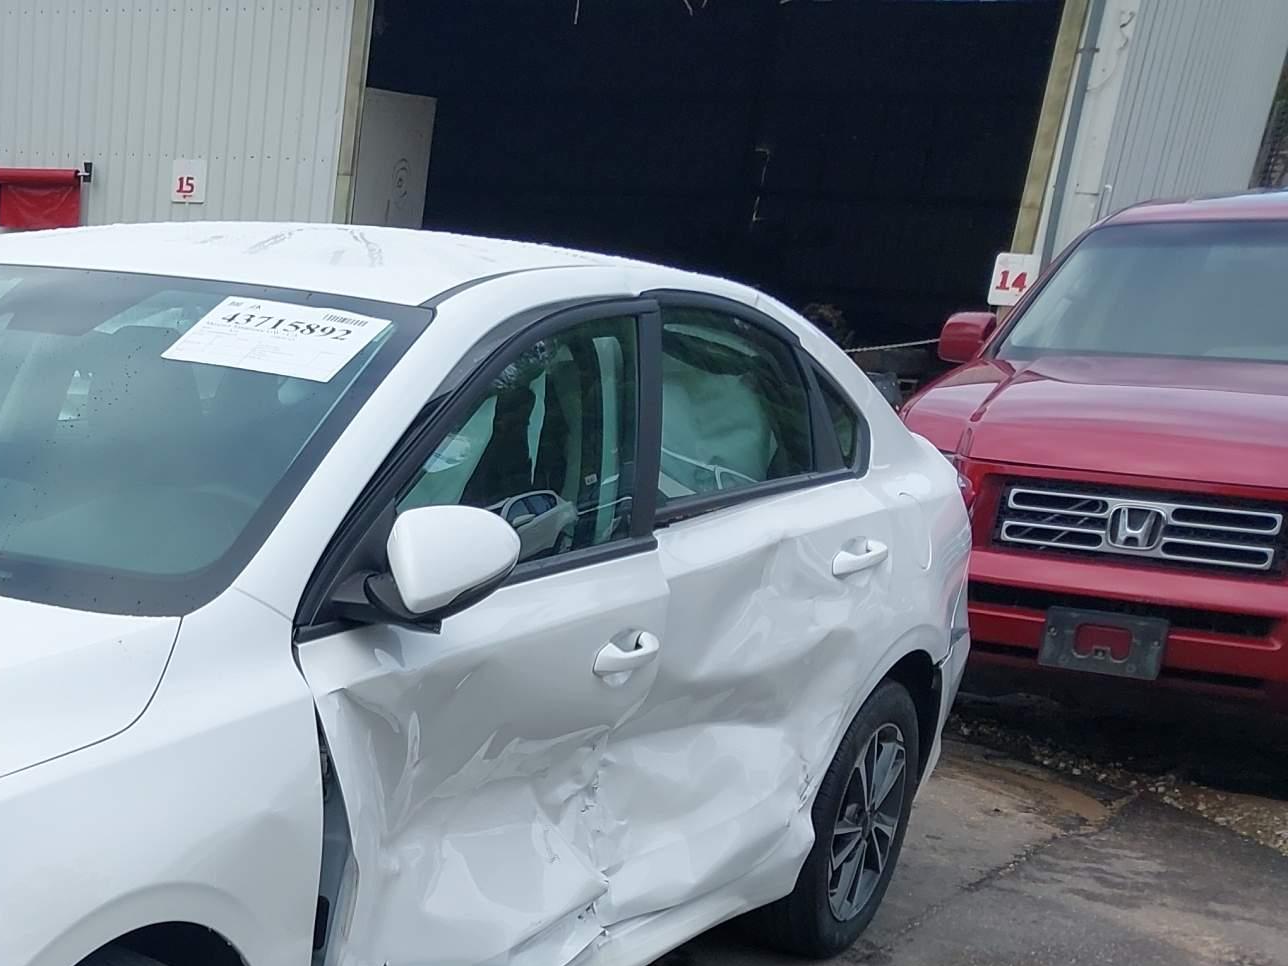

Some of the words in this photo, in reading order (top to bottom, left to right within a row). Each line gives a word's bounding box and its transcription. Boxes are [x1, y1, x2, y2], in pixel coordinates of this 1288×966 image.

[176, 176, 194, 194] 15
[995, 270, 1027, 292] 14
[221, 311, 353, 341] 43715892
